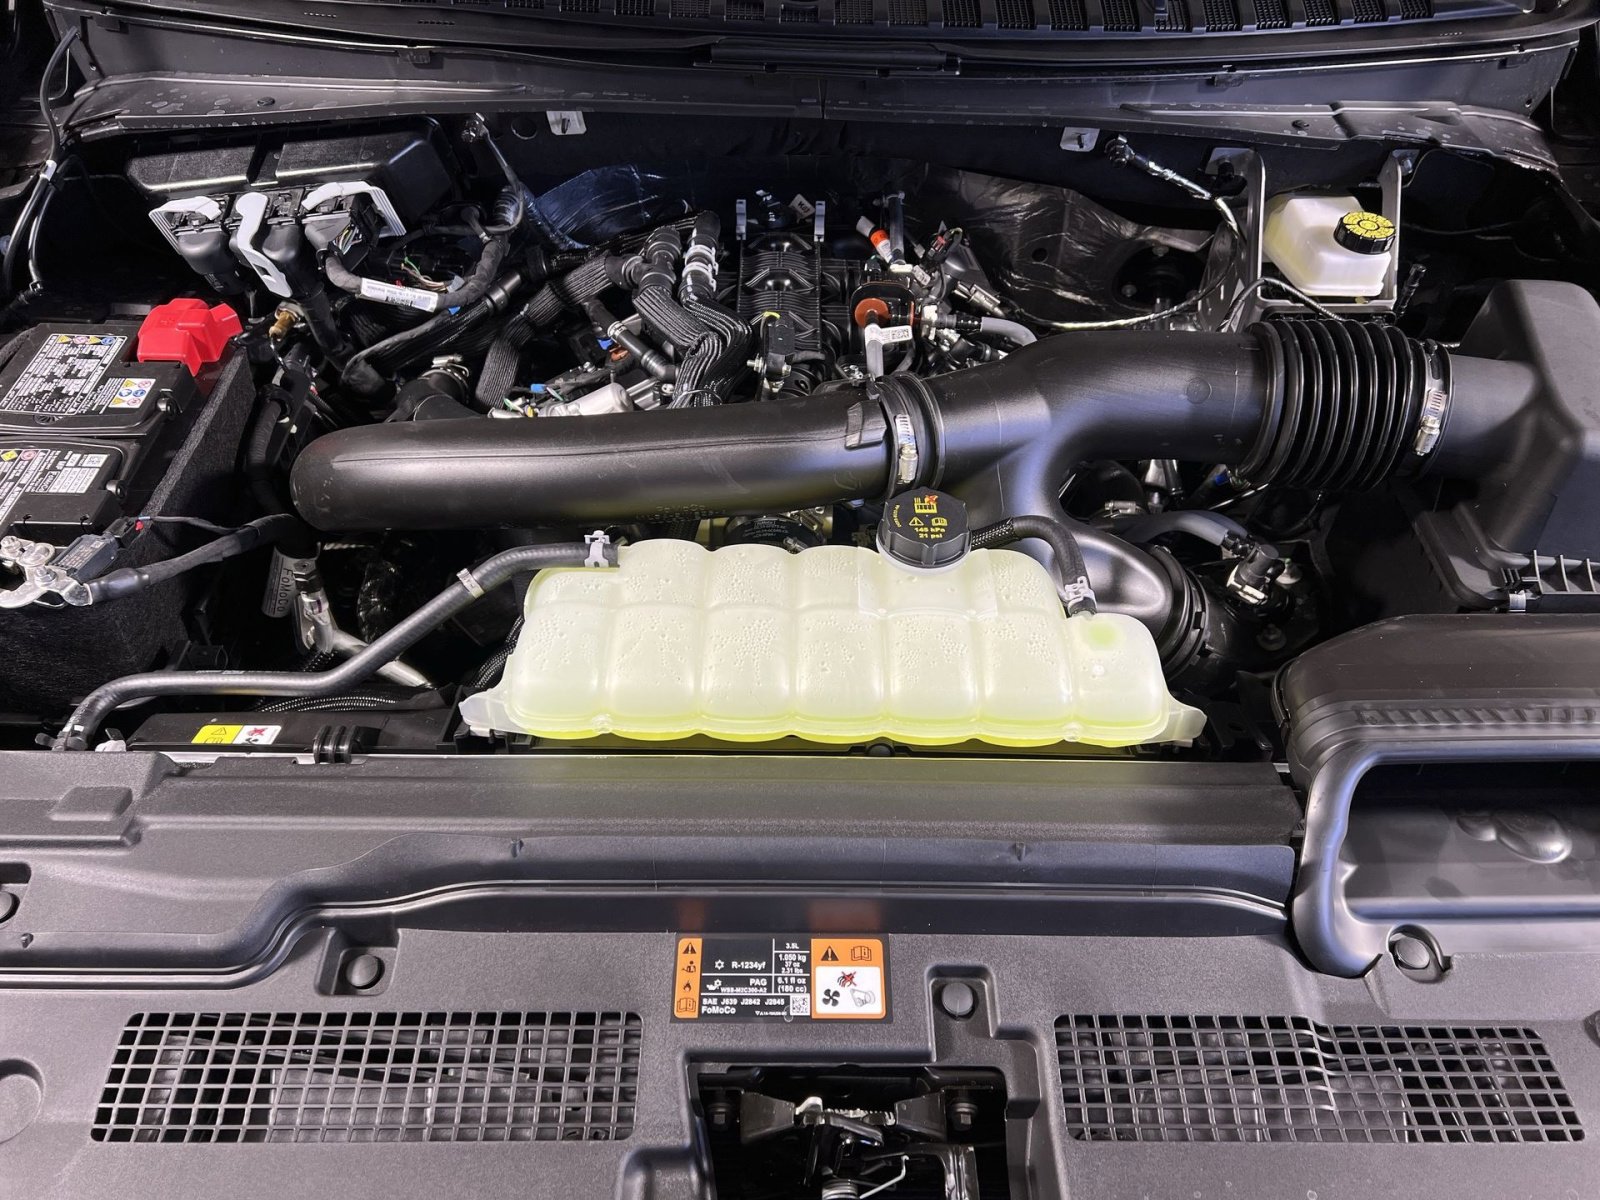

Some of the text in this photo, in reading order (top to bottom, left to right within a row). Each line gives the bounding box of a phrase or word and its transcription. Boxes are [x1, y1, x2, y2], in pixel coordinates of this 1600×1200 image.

[276, 567, 294, 612] FoMoCo
[797, 954, 807, 963] kg
[731, 961, 766, 971] R-1234yf
[749, 978, 768, 986] PAG
[777, 985, 808, 993] (180 cc)
[701, 1006, 737, 1014] FoMoCo
